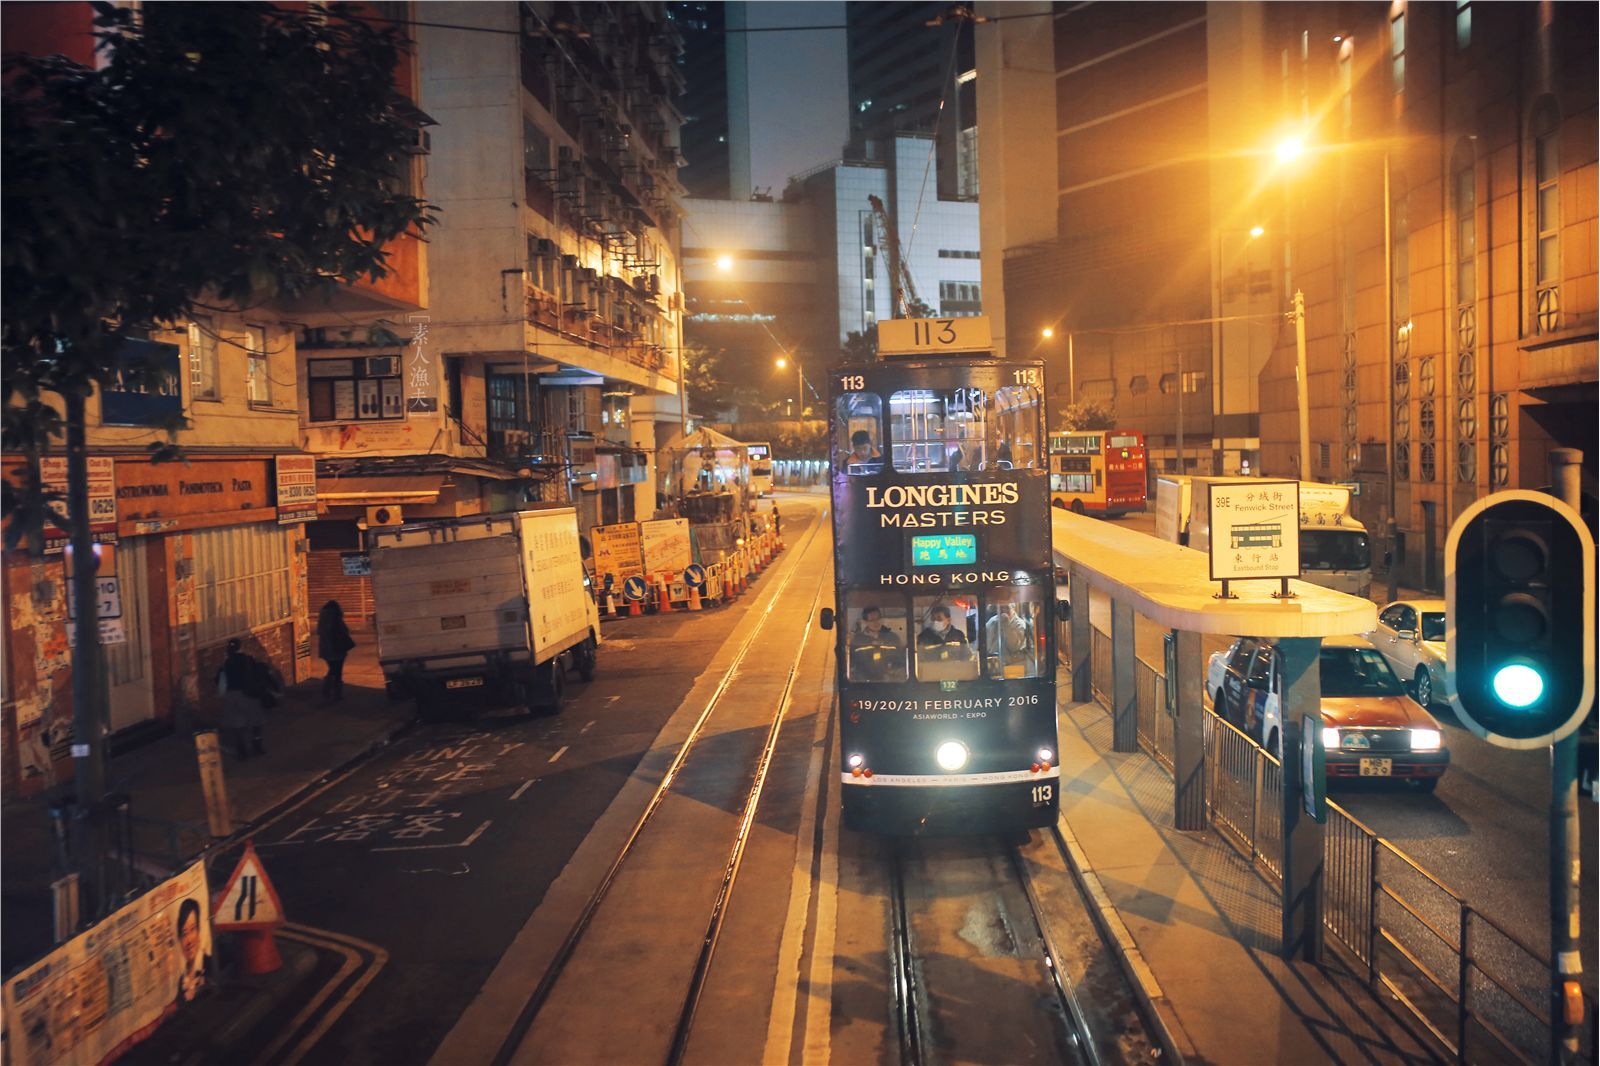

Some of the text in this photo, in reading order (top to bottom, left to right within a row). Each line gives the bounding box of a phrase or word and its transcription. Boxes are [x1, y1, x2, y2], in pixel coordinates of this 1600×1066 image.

[913, 319, 957, 346] 113
[841, 376, 864, 390] 113
[1013, 370, 1036, 384] 113
[866, 482, 1019, 508] LONGINES
[1215, 496, 1231, 508] 39E
[1235, 503, 1294, 512] Fenwick Street
[881, 510, 1006, 528] MASTERS
[912, 536, 973, 549] Happy Valley
[1265, 564, 1279, 572] Stop
[880, 571, 1010, 585] HONG KONG
[858, 695, 1038, 711] 19/20/21 FEBRUARY 2016
[966, 711, 987, 719] EXPO
[1031, 785, 1053, 802] 113
